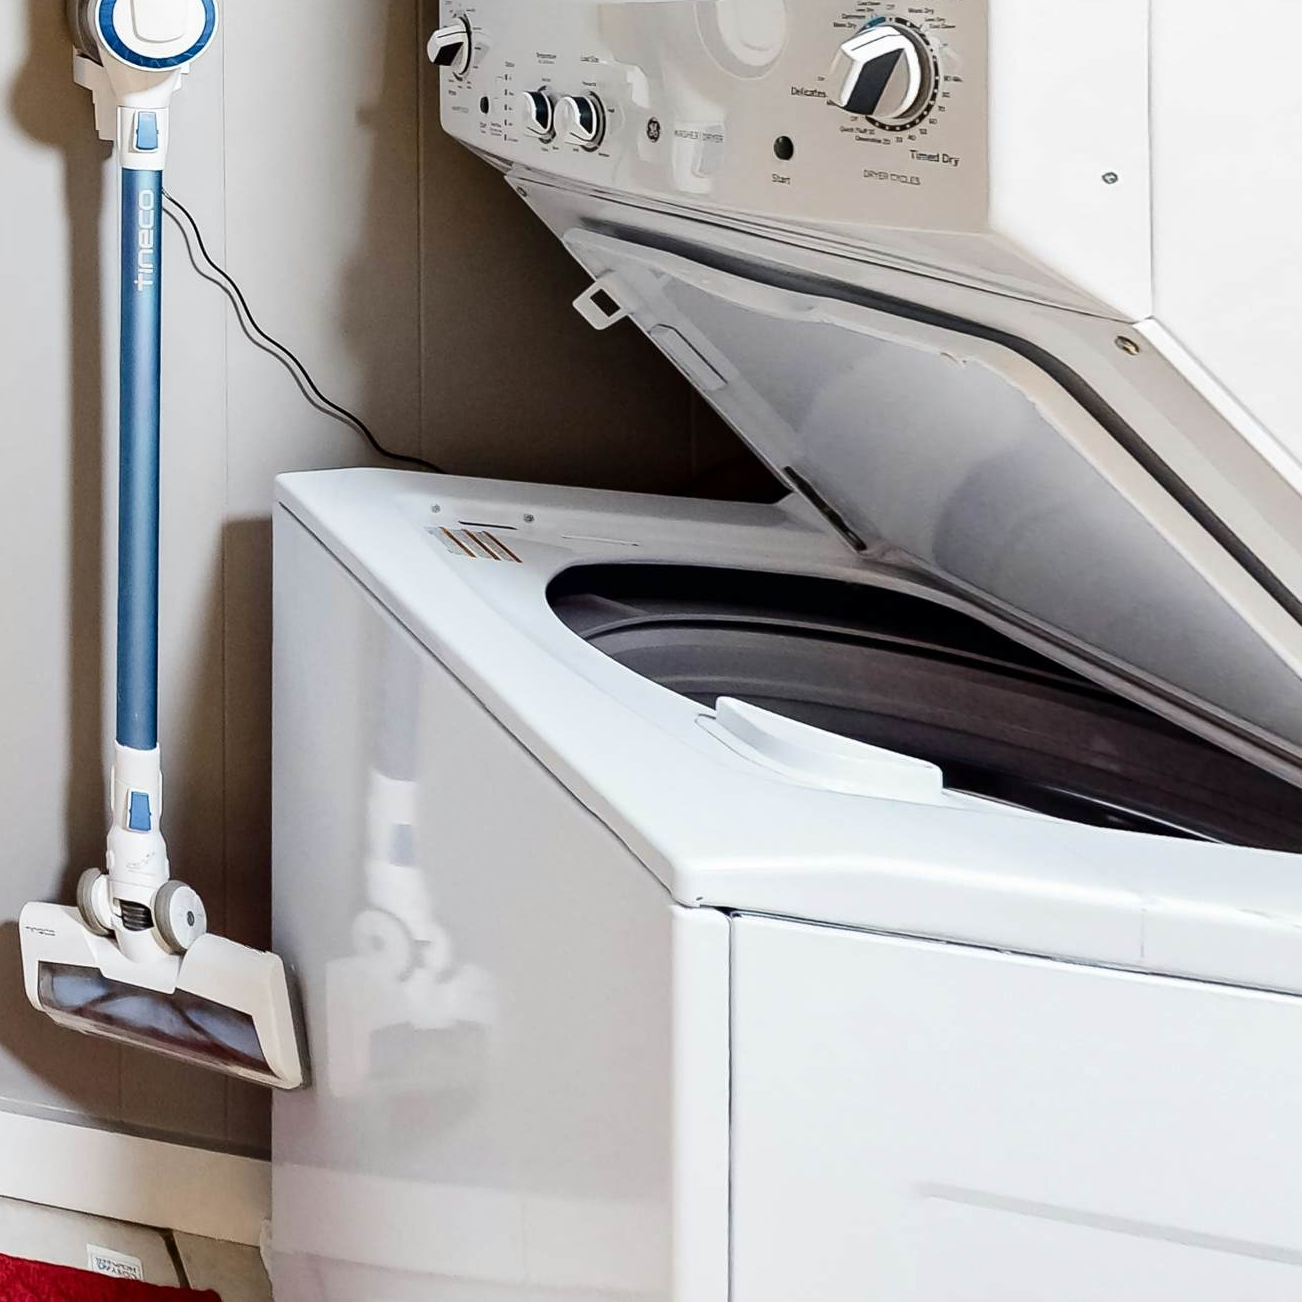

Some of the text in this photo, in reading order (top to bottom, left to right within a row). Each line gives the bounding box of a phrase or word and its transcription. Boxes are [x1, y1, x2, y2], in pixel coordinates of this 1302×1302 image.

[909, 149, 960, 168] Timed Dry
[771, 173, 791, 185] Start
